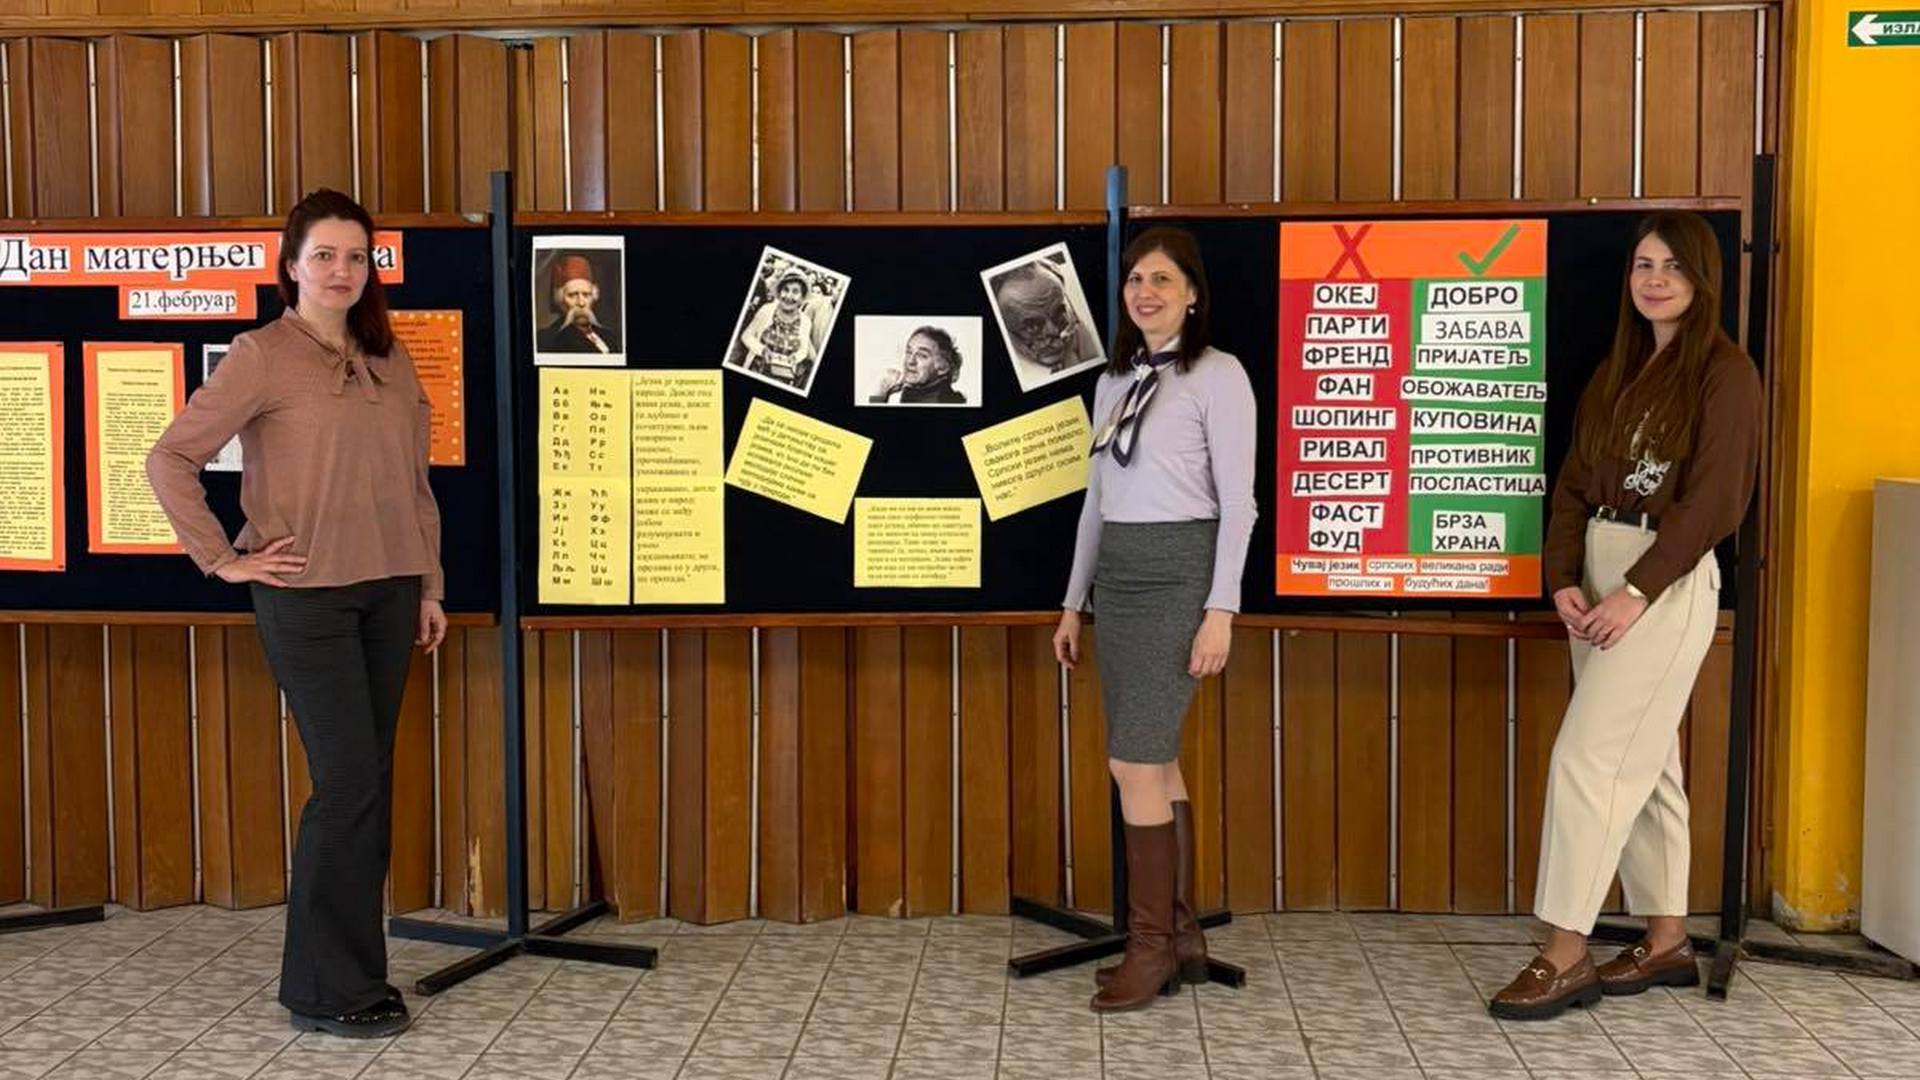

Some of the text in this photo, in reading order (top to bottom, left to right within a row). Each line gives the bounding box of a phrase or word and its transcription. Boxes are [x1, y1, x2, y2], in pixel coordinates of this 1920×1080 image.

[1883, 24, 1920, 33] ИЗЛ
[0, 240, 263, 278] Дан матерњег
[132, 293, 236, 312] 21.фебруар
[1316, 286, 1376, 304] ОКЕЈ
[1431, 287, 1518, 307] ДОБРО
[1307, 317, 1386, 335] ПАРТИ
[1436, 321, 1523, 339] ЗАБАВА
[1305, 346, 1389, 366] ФРЕНД
[1418, 349, 1528, 365] ПРИЈАТЕЉ
[1319, 377, 1371, 395] ФАН
[1403, 380, 1545, 399] ОБОЖАВАТЕЉ
[1295, 410, 1393, 426] ШОПИНГ
[1414, 411, 1536, 433] КУПОВИНА
[1304, 440, 1384, 458] РИВАЛ
[1411, 449, 1530, 464] ПРОТИВНИК
[1294, 472, 1389, 493] ДЕСЕРТ
[1410, 476, 1544, 493] ПОСЛАСТИЦА
[1312, 505, 1379, 523] ФАСТ
[1437, 515, 1486, 529] БРЗА
[1311, 530, 1360, 550] ФУД
[1436, 535, 1500, 550] ХРАНА
[1292, 560, 1507, 572] Чувај језик српских великана ради
[1407, 578, 1452, 590] будућих
